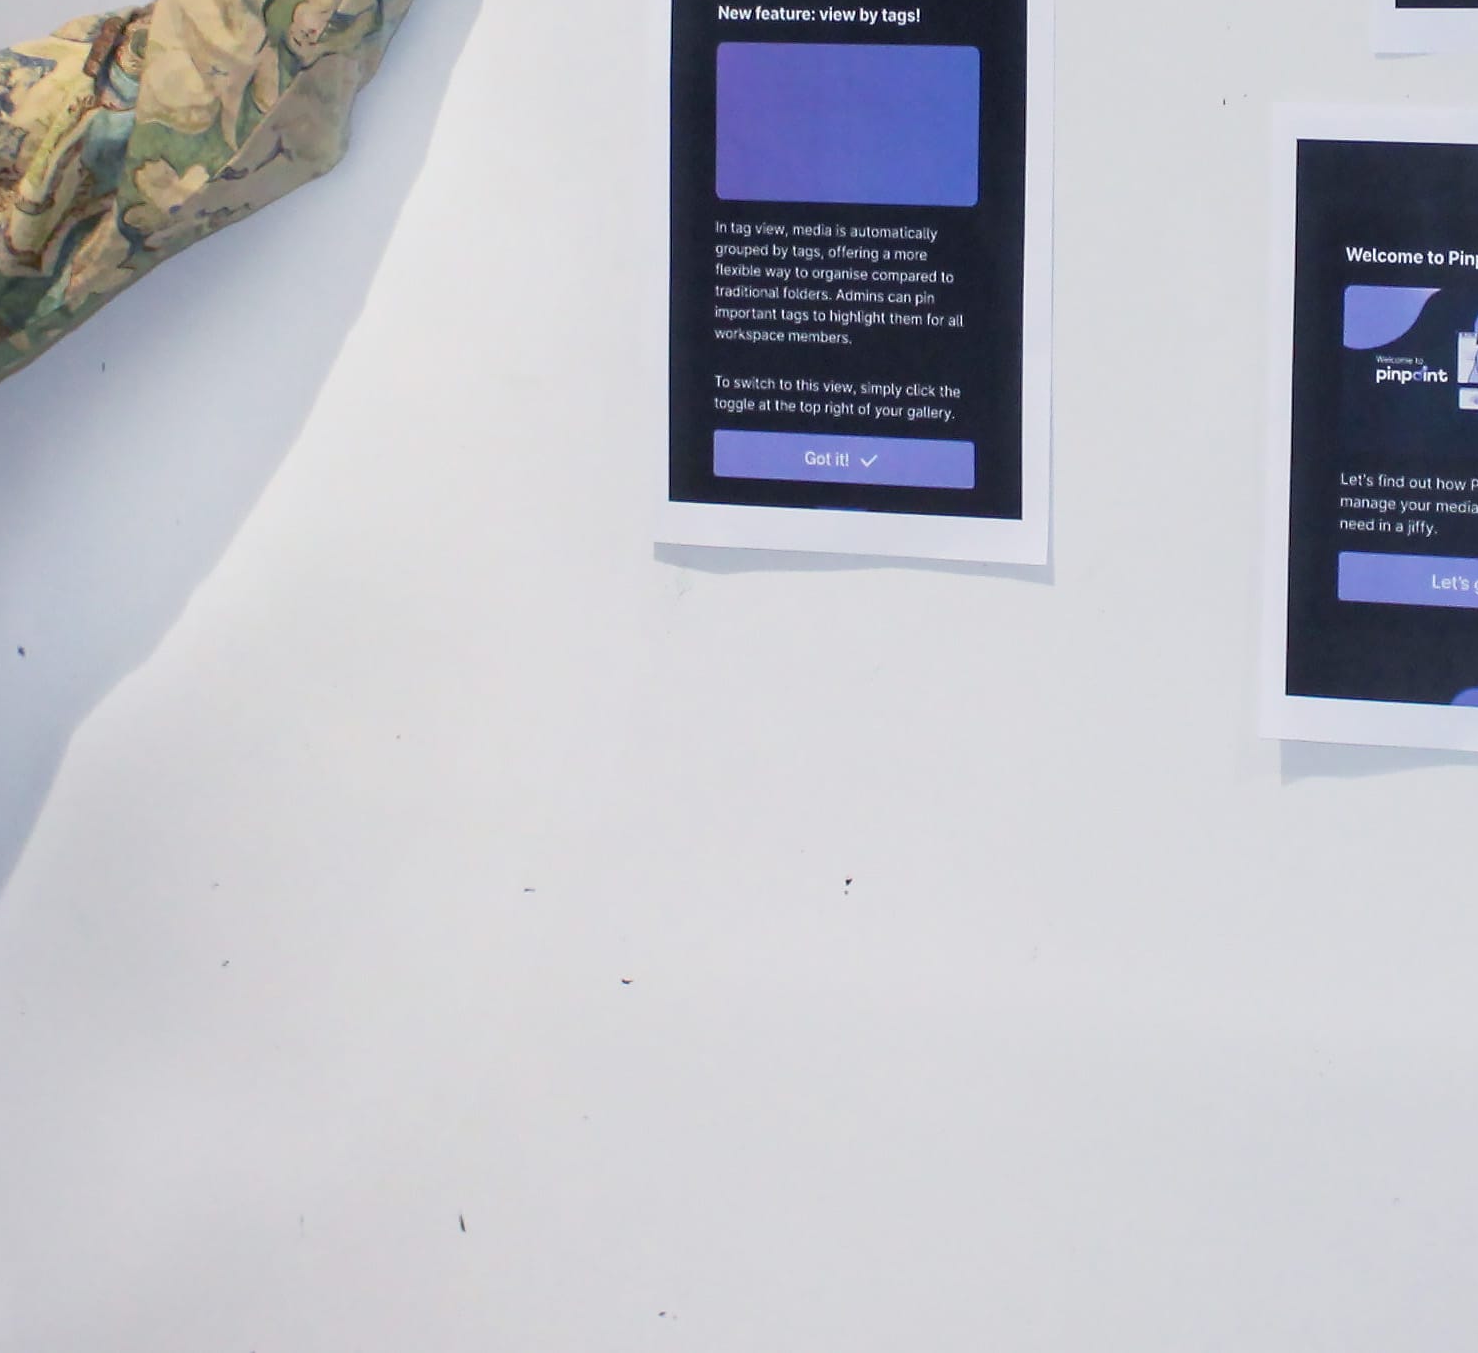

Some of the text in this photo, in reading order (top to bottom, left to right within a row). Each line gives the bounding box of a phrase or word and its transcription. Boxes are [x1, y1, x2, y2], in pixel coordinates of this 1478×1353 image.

[718, 5, 920, 25] New feature: view by tags!
[715, 221, 937, 242] In tag view, media is automatically
[715, 243, 927, 262] grouped by tags, offering a more
[1345, 247, 1423, 263] Welcome
[1427, 250, 1444, 264] to
[715, 263, 953, 283] flexible way to organise compared to
[715, 285, 934, 306] traditional folders. Admins can pin
[715, 305, 963, 326] important tags to highlight them for all
[714, 329, 851, 344] workspace members.
[1375, 365, 1448, 384] pinpoint
[715, 375, 960, 398] To switch to this view, simply click the
[714, 397, 955, 422] toggle at the top right of your gallery.
[804, 451, 849, 466] Got it!
[1341, 473, 1373, 486] Let's
[1378, 474, 1404, 488] find
[1409, 477, 1431, 489] out
[1436, 477, 1466, 490] how
[1340, 497, 1395, 512] manage
[1400, 500, 1431, 513] your
[1435, 500, 1478, 513] media
[1339, 518, 1437, 537] need in a jiffy.
[1431, 574, 1469, 590] Let's
